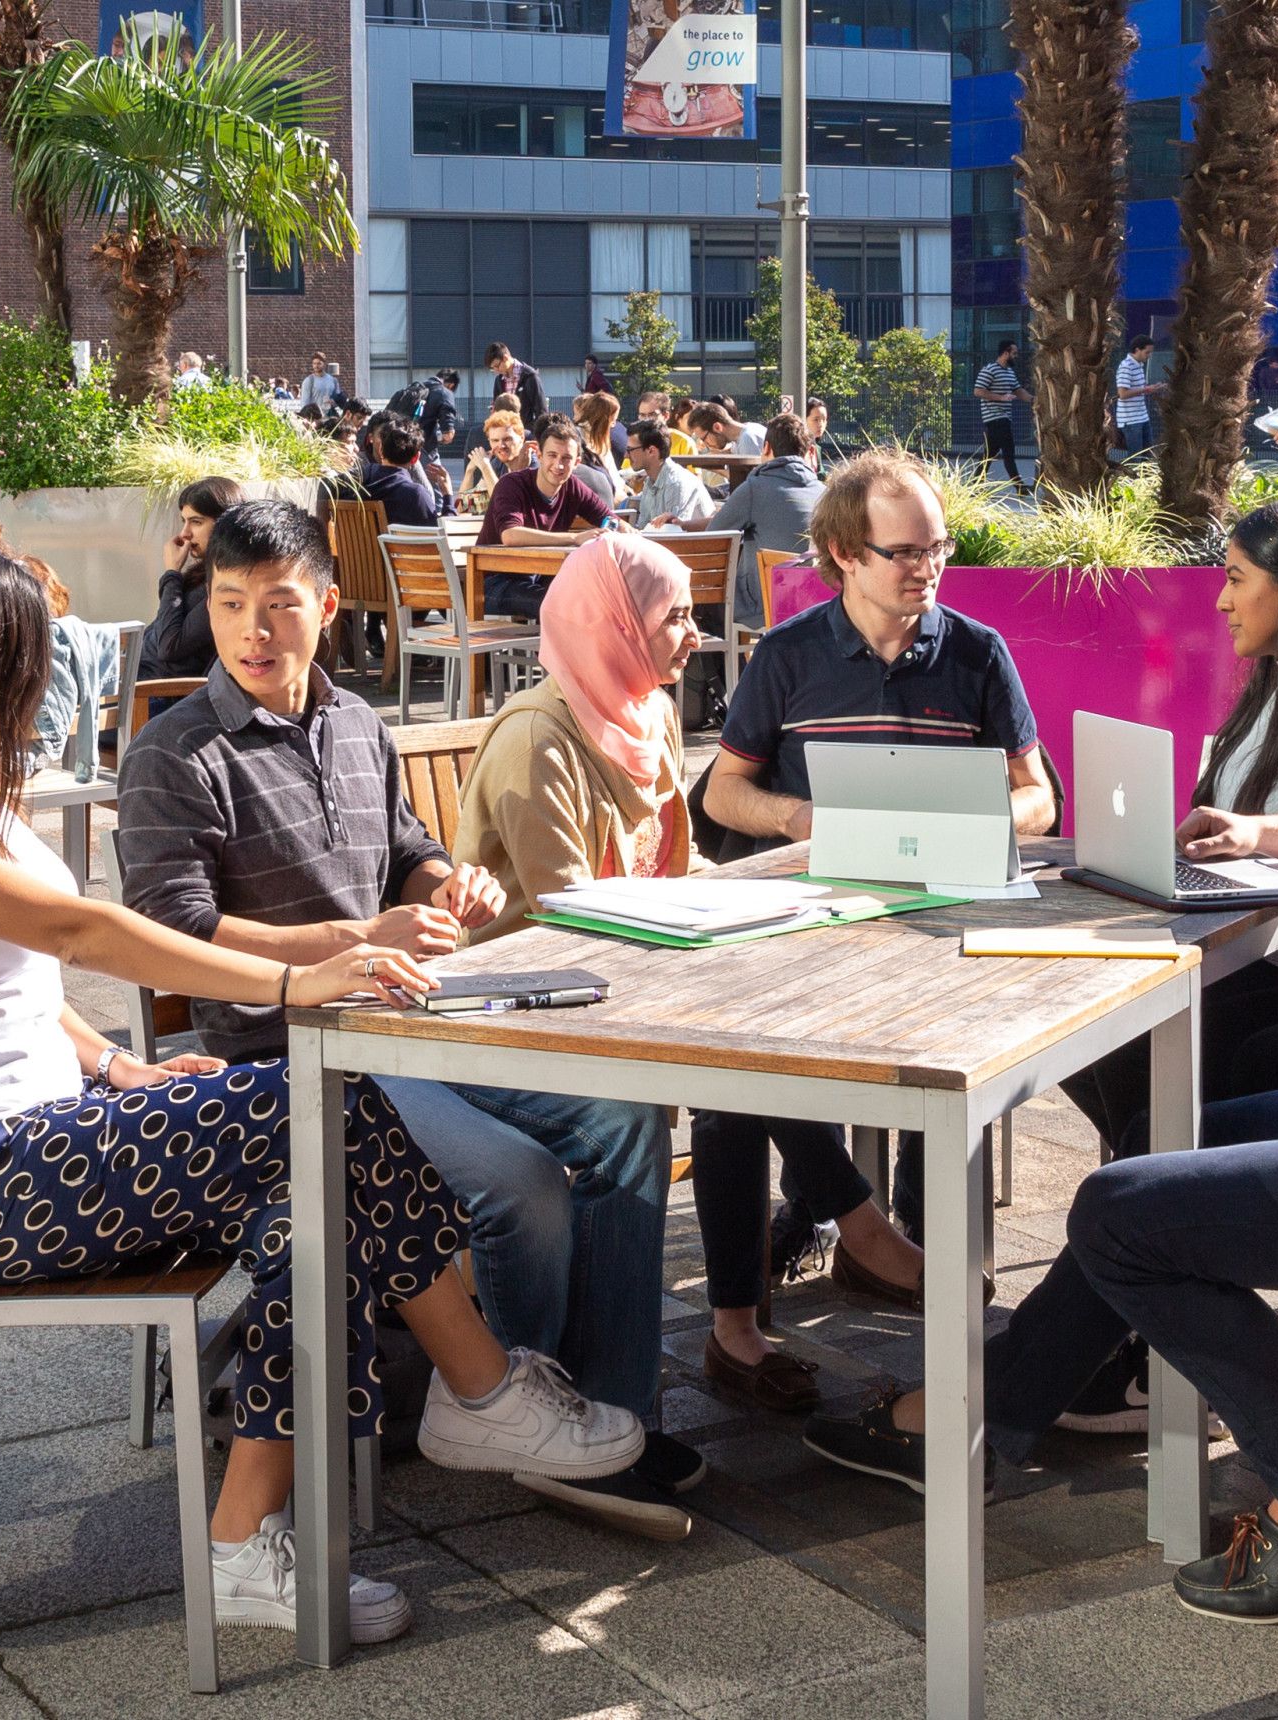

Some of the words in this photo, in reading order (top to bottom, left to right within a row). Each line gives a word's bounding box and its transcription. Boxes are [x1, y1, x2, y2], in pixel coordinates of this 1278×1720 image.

[683, 28, 700, 39] the
[701, 30, 730, 42] place
[732, 31, 744, 40] to
[686, 49, 745, 71] grow
